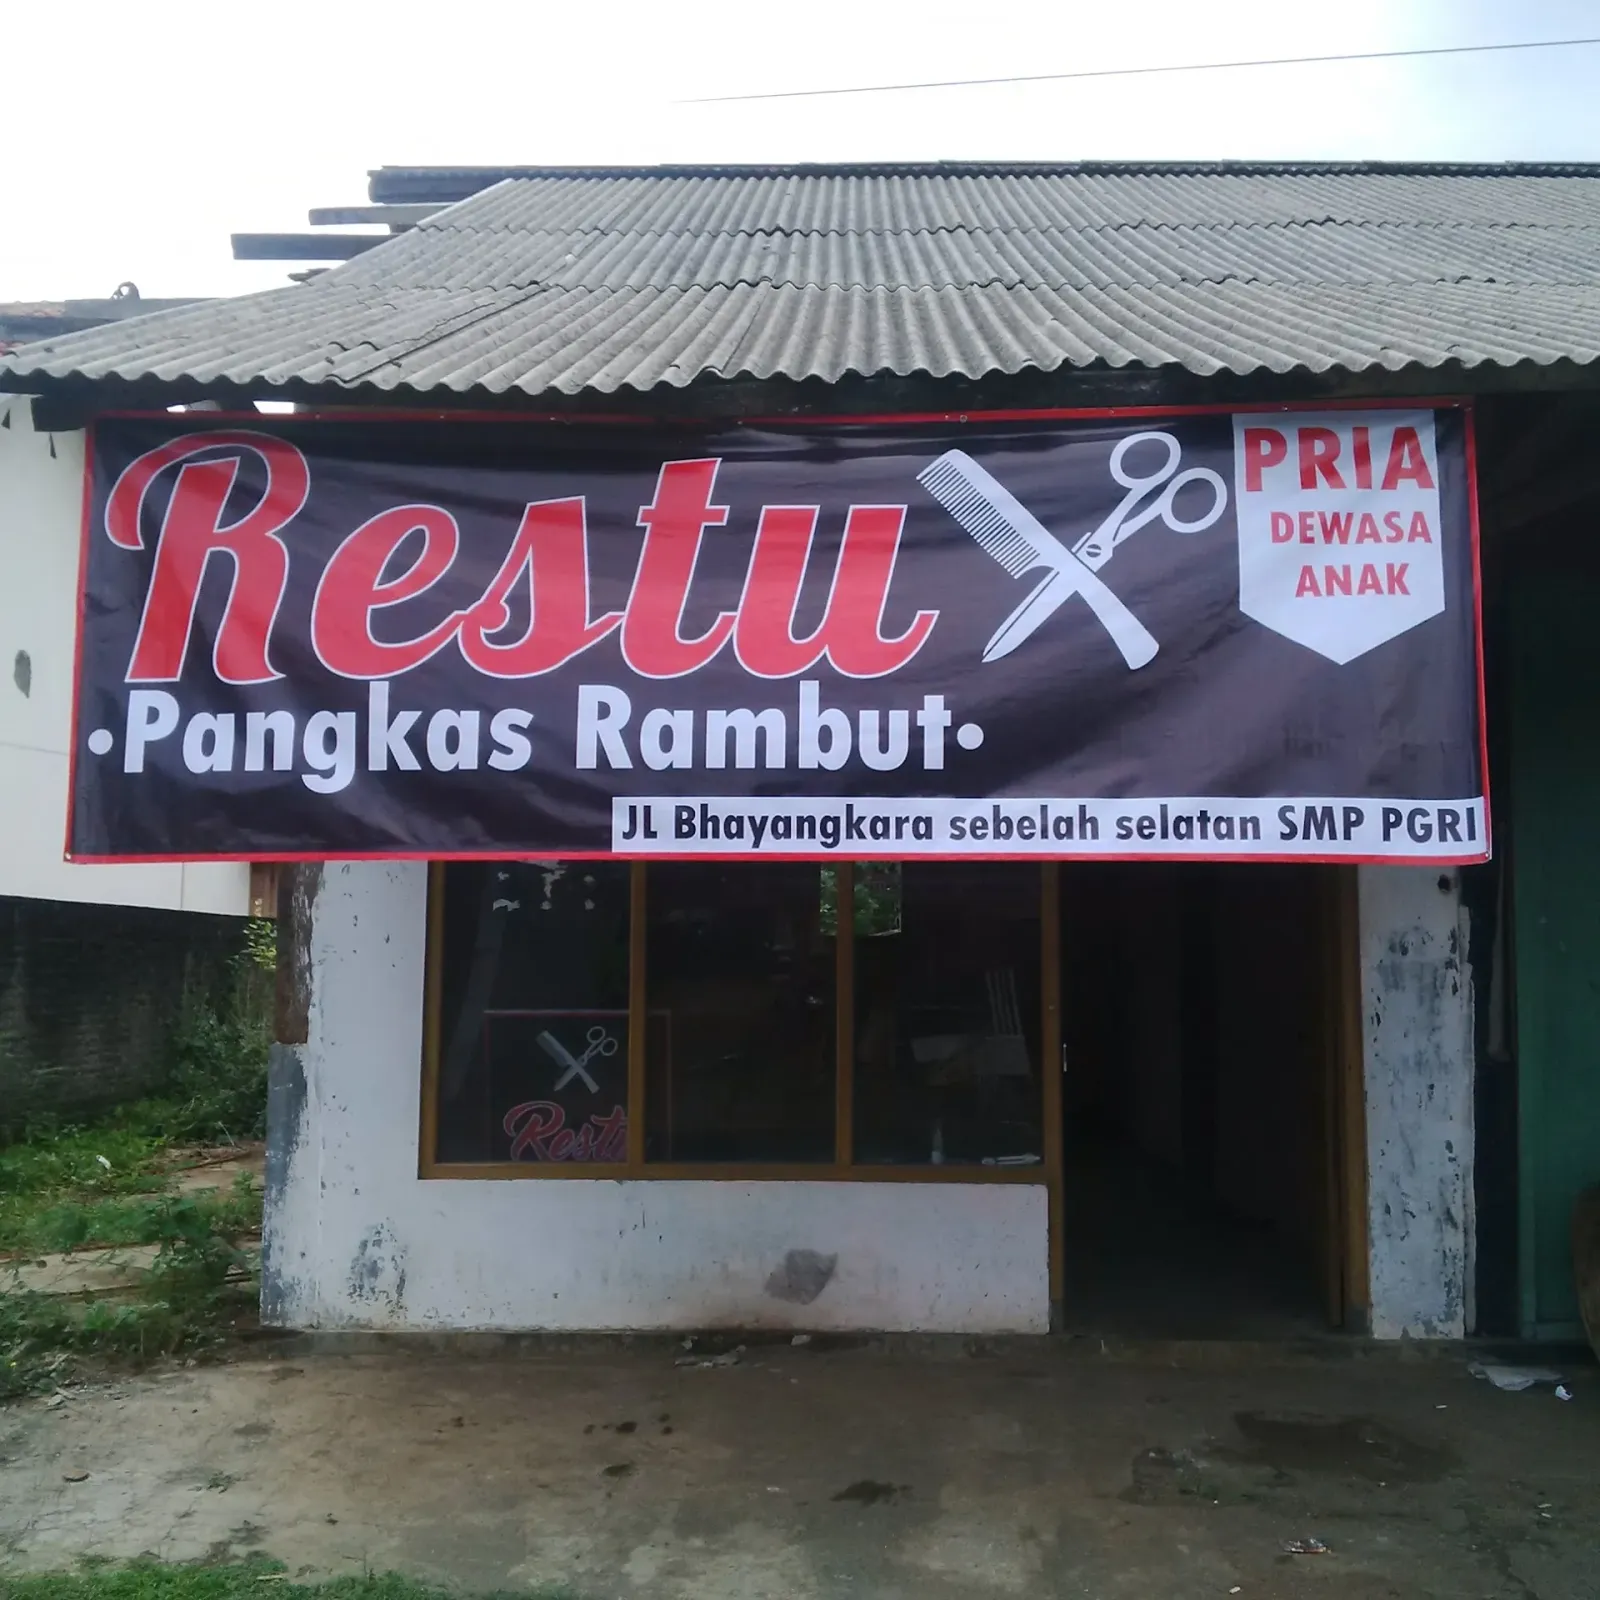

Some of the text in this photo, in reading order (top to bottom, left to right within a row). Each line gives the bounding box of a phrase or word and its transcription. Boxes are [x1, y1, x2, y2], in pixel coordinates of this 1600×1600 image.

[1244, 426, 1435, 492] PRIA
[1270, 511, 1433, 544] DEWASA
[104, 430, 939, 686] Restu
[1295, 563, 1411, 598] ANAK
[622, 803, 1477, 848] JL Bhayangkara sebelah selatan SMP PGRI
